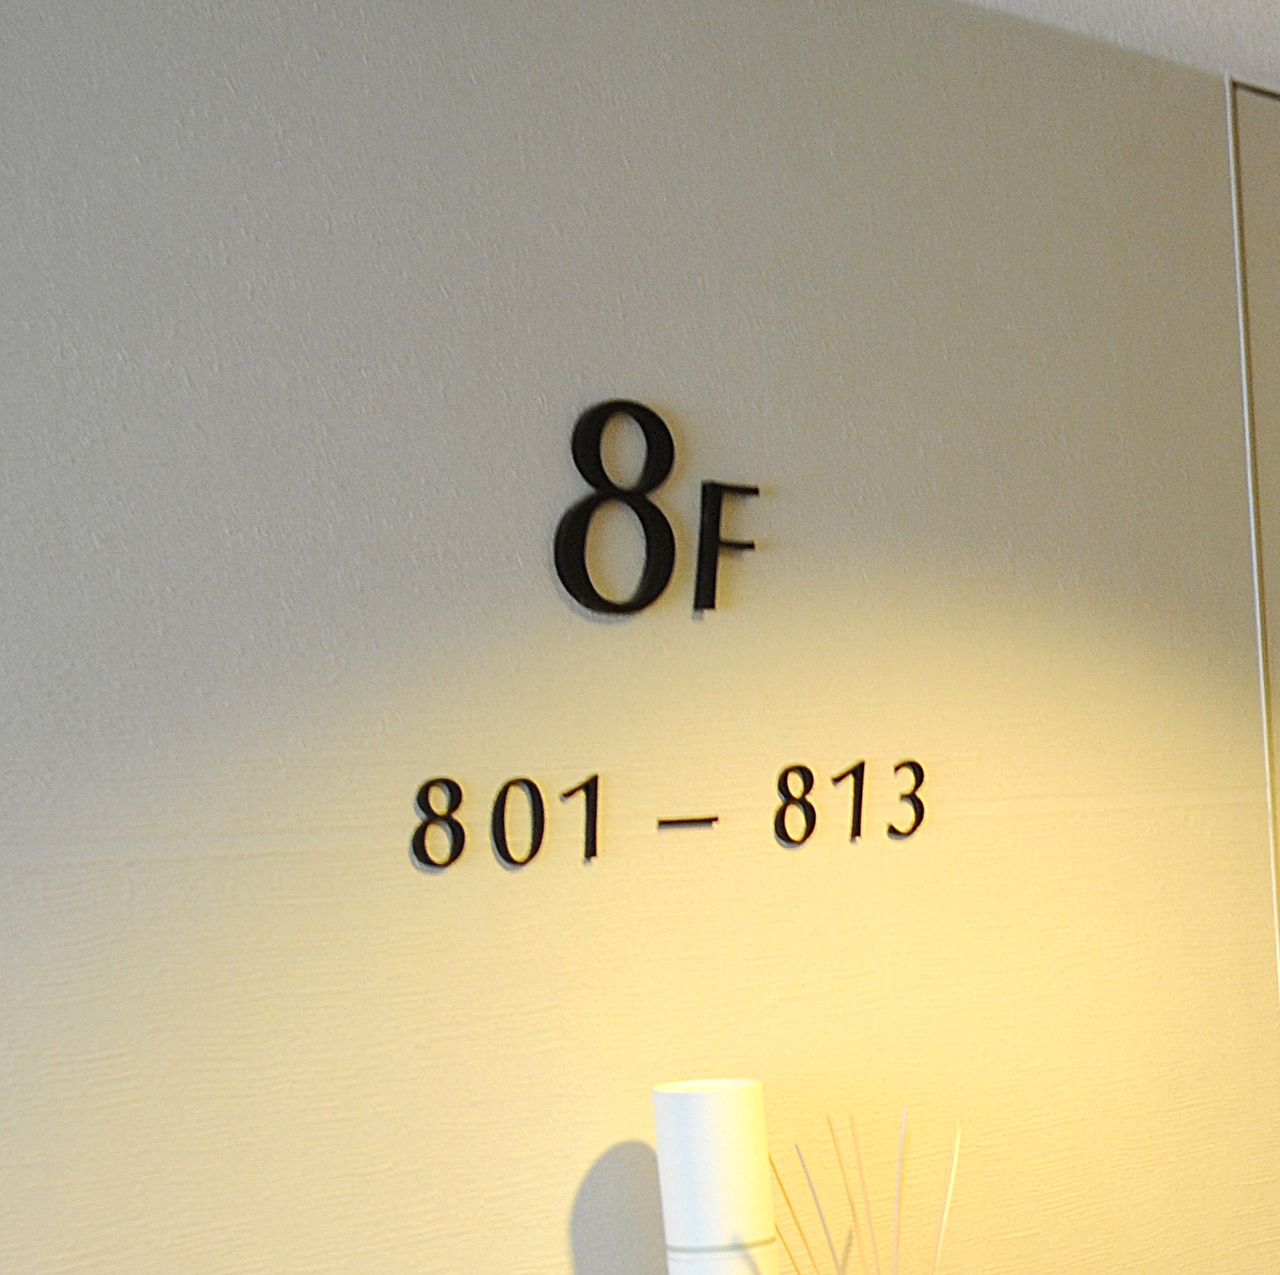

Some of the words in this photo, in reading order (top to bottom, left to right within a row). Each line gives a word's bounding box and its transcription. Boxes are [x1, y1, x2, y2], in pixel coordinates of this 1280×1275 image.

[553, 398, 761, 617] 8F
[410, 773, 600, 867] 801
[773, 760, 926, 848] 813
